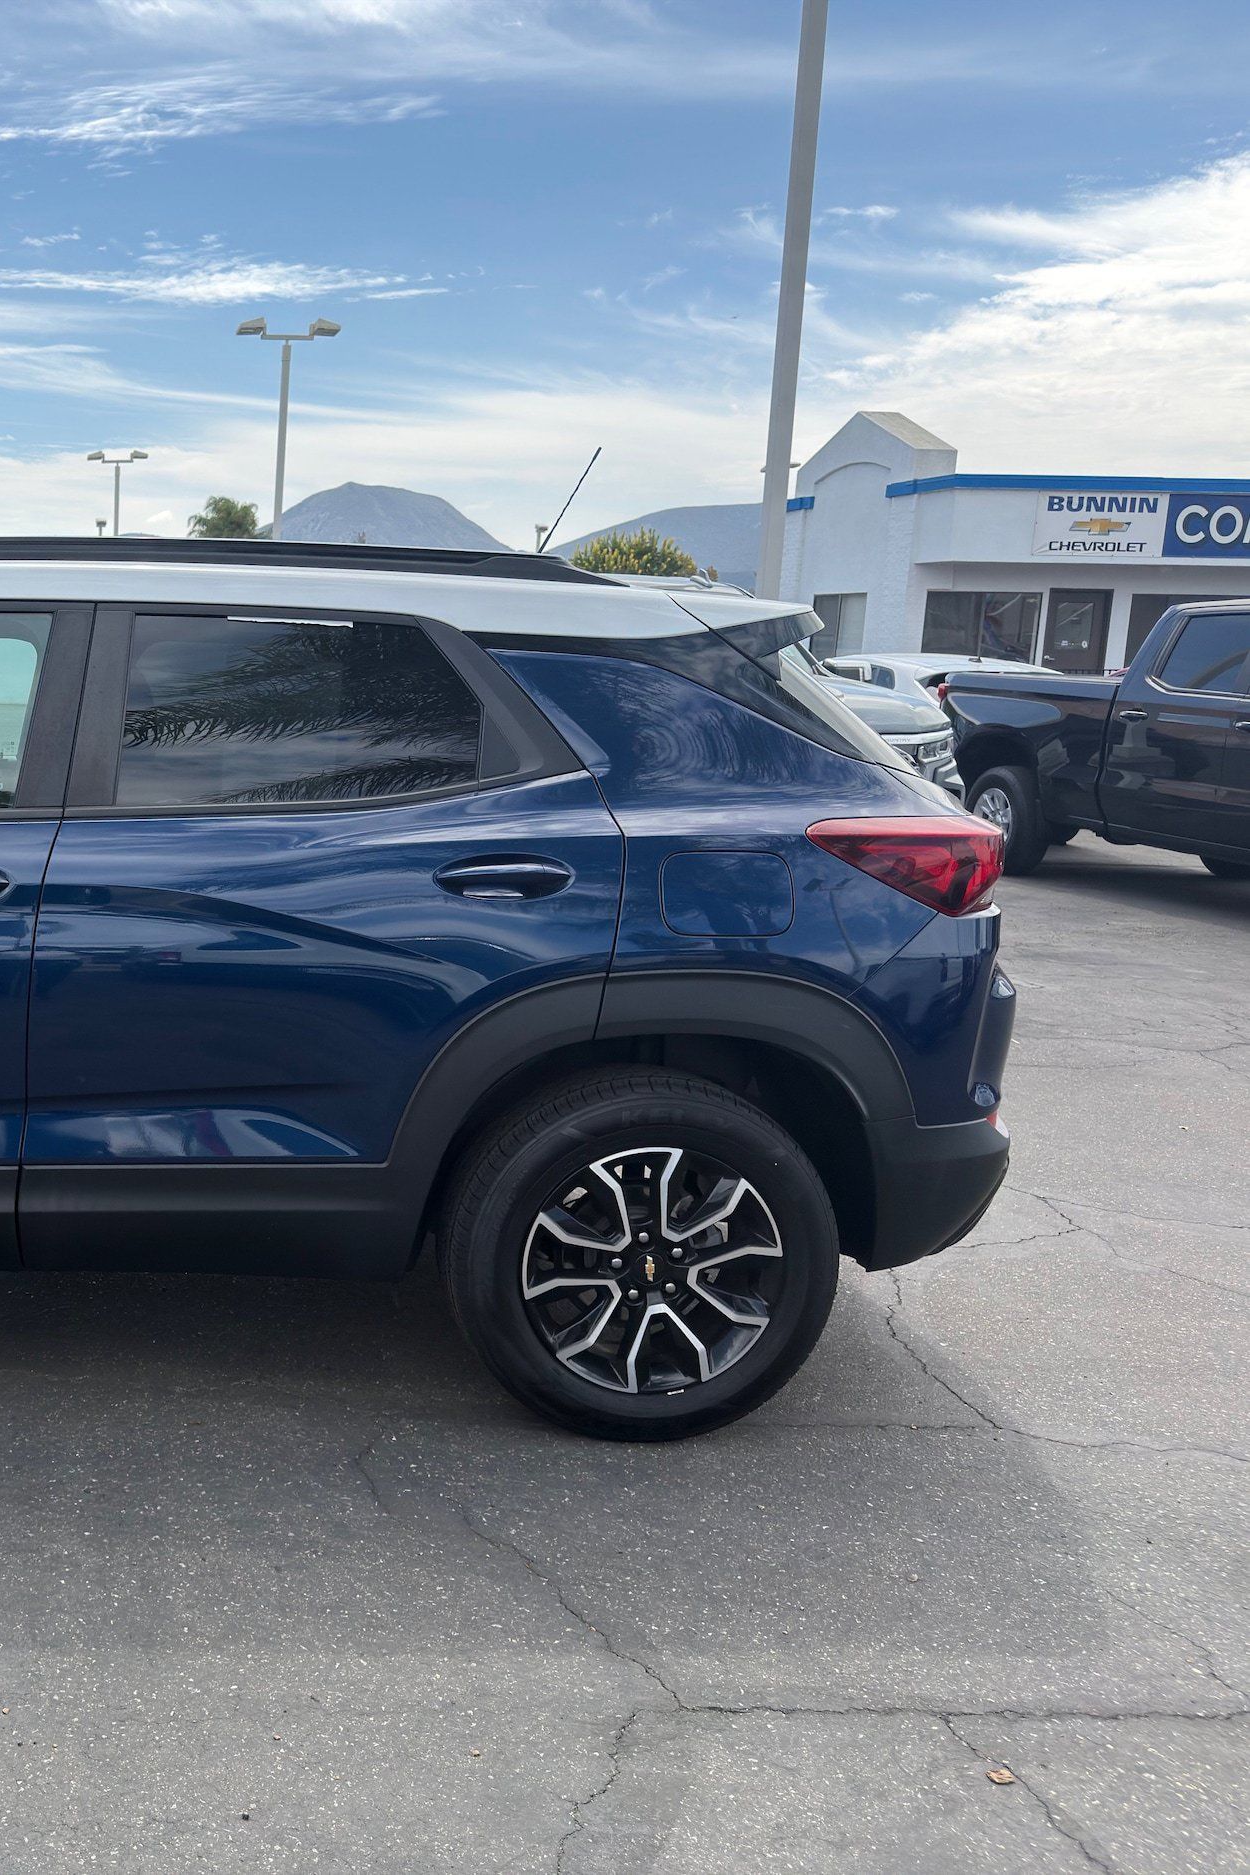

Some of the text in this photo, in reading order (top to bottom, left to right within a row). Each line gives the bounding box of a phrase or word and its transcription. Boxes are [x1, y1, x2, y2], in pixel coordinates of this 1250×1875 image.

[1047, 496, 1159, 513] BUNNIN
[1176, 504, 1250, 544] CO
[1049, 541, 1147, 553] CHEVROLET
